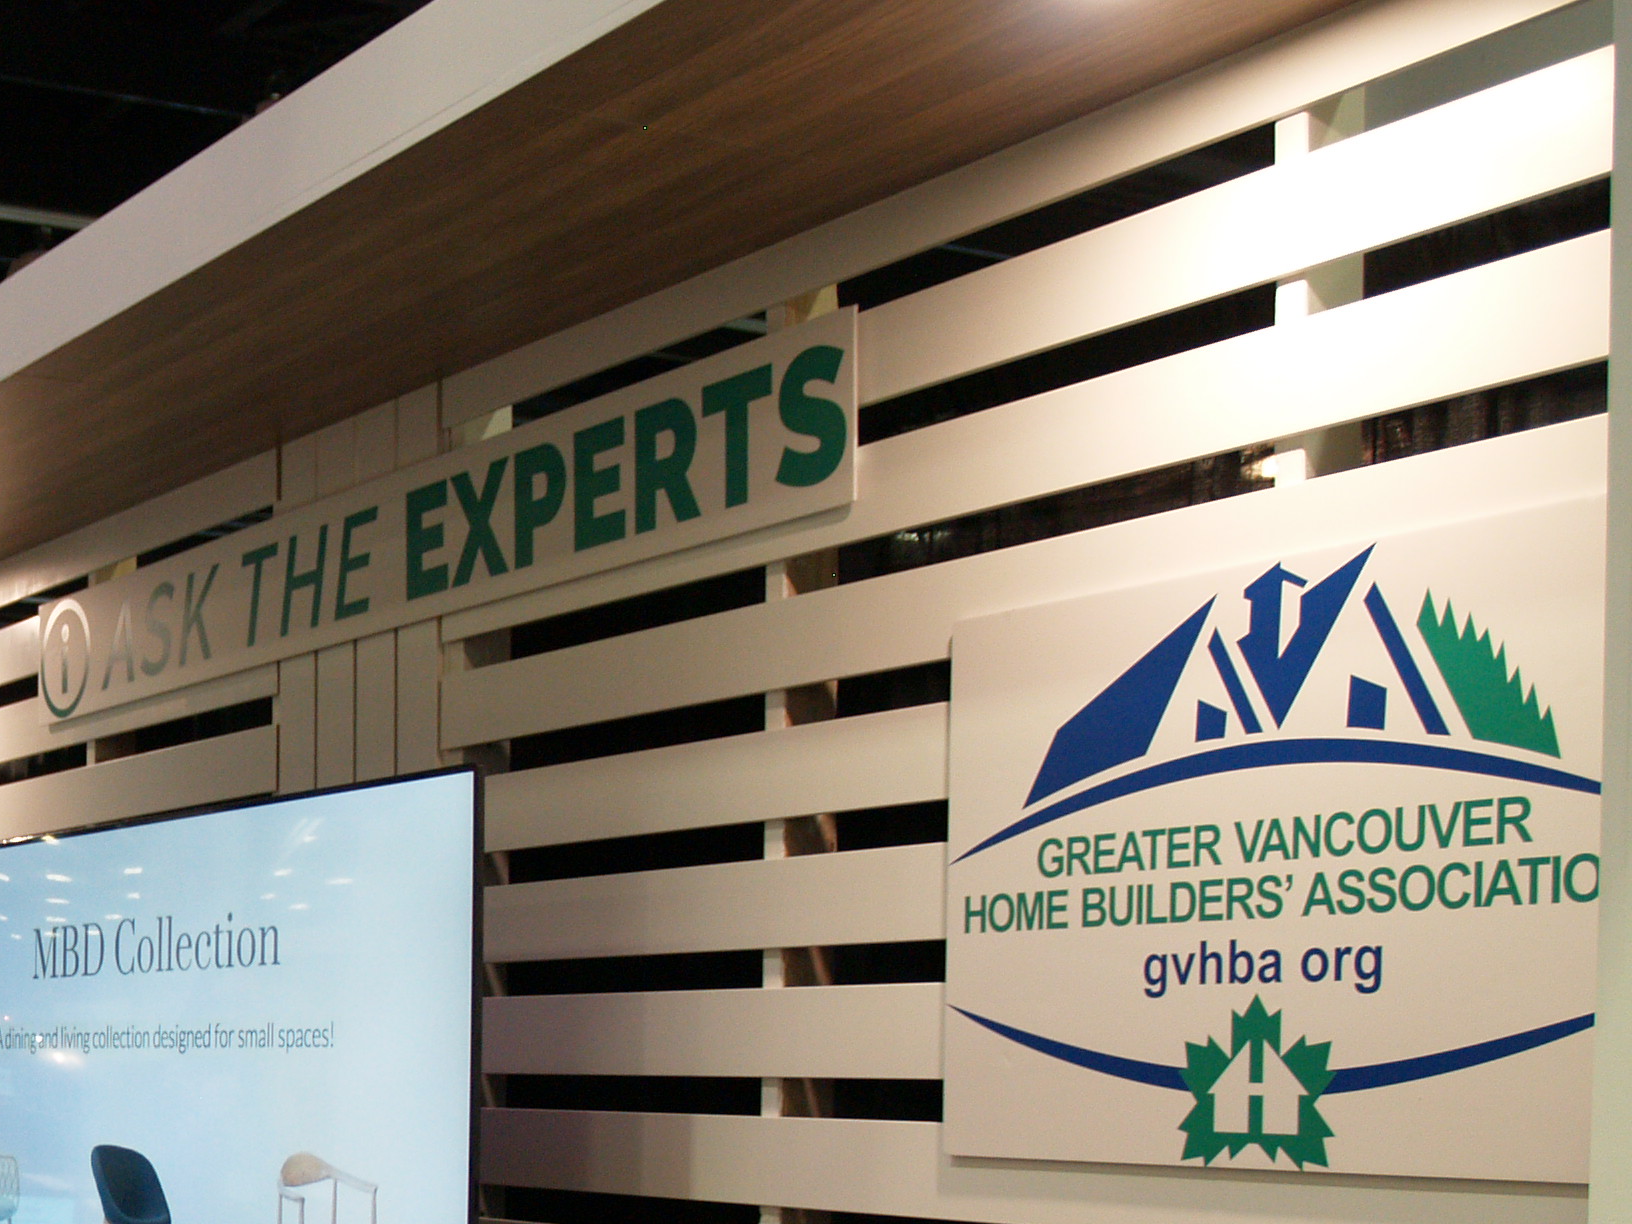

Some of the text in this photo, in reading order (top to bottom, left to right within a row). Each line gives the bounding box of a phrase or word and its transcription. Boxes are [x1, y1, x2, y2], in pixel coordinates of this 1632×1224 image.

[101, 343, 848, 692] ASK THE EXPERTS
[1037, 795, 1533, 878] GREATER VANCOUVER
[963, 887, 1069, 934] HOME
[1081, 873, 1293, 928] BUILDERS'
[32, 911, 281, 980] MBD Collection
[1143, 939, 1384, 998] gvhba org
[4, 1026, 37, 1054] dining
[38, 1025, 59, 1050] and
[60, 1025, 91, 1054] living
[92, 1024, 150, 1050] collection
[152, 1023, 212, 1054] designed
[213, 1022, 235, 1048] for
[238, 1022, 275, 1048] small
[278, 1021, 335, 1053] spaces!
